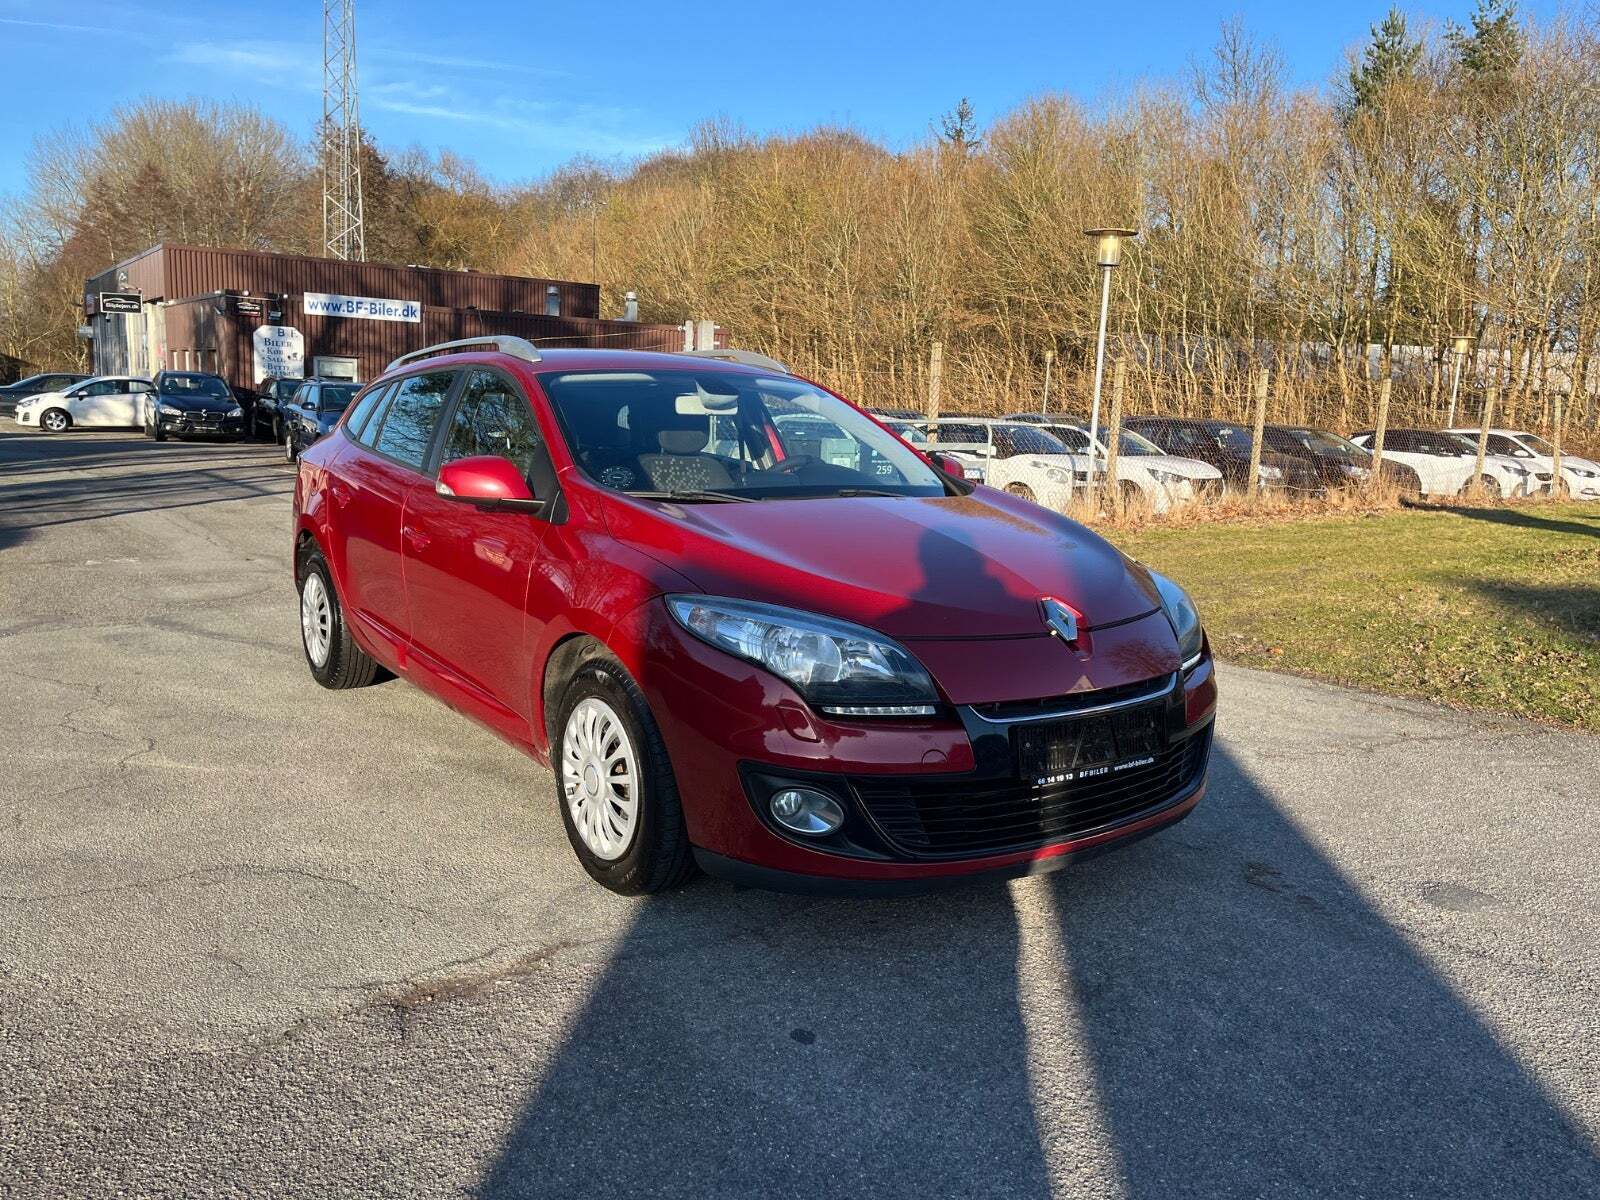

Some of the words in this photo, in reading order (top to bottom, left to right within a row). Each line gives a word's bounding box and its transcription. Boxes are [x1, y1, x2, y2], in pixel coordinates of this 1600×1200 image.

[308, 300, 418, 318] www.BF-Biler.dk
[876, 465, 892, 475] 259
[1047, 775, 1055, 783] 14
